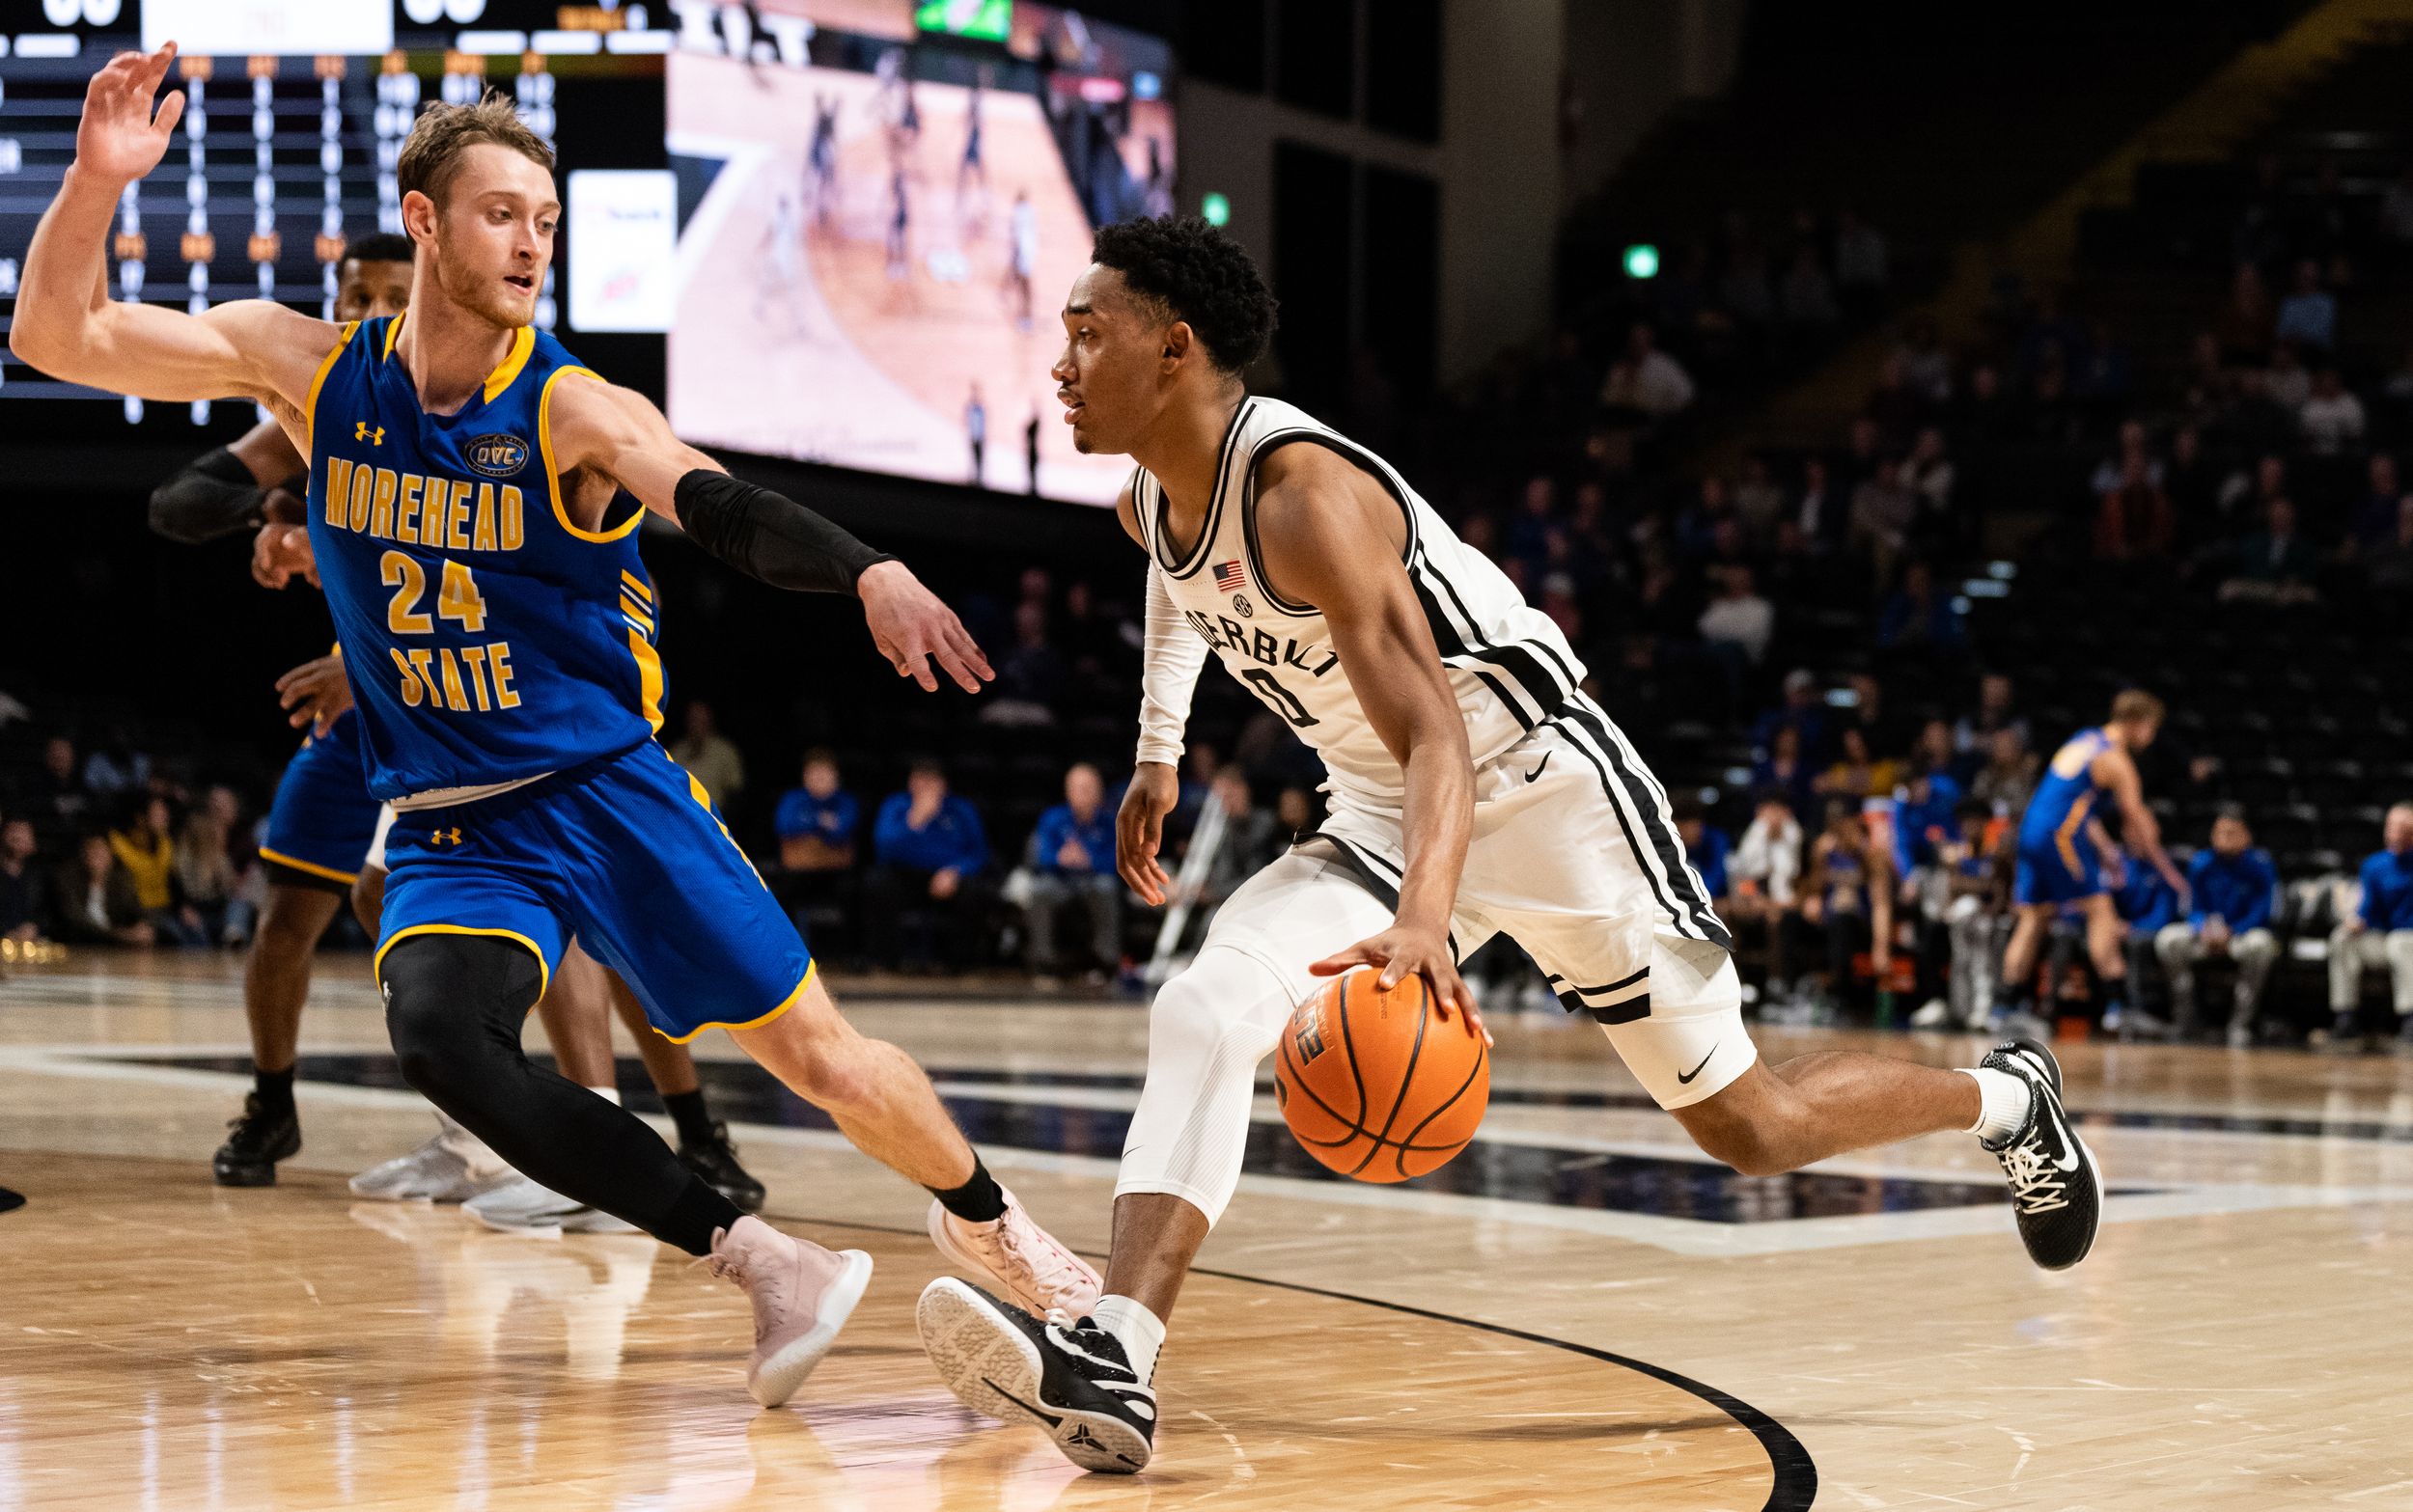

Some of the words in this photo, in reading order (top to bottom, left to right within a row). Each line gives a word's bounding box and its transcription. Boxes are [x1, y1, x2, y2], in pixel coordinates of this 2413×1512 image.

[477, 446, 515, 465] OVC
[325, 456, 524, 552] MOREHEAD
[380, 551, 487, 634] 24
[390, 643, 521, 712] STATE
[1241, 668, 1319, 729] 0
